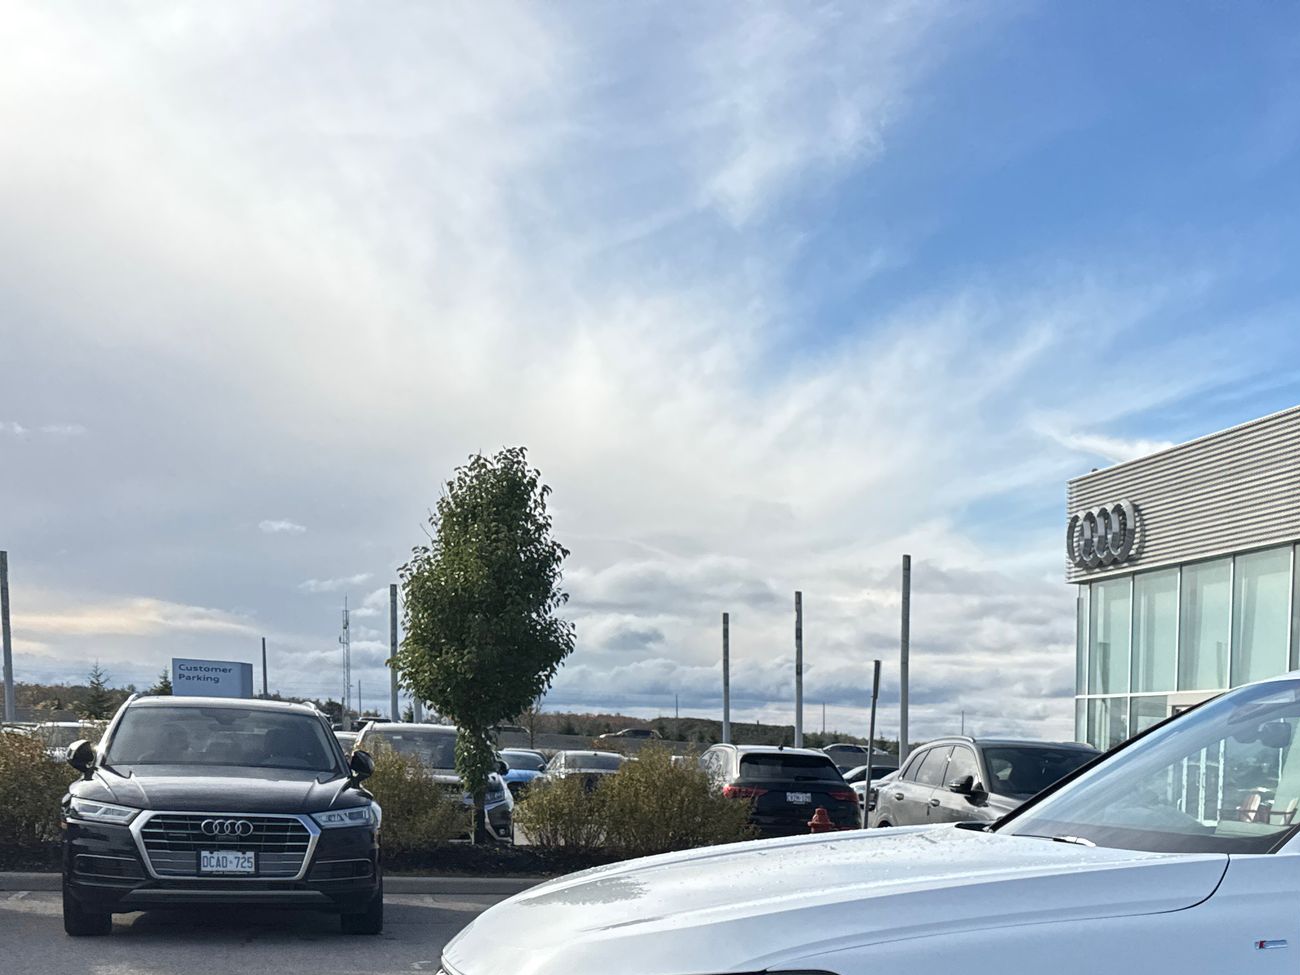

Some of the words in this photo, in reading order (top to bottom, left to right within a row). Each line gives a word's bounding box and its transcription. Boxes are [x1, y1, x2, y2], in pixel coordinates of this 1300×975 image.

[178, 664, 232, 674] Customer
[178, 673, 220, 684] Parking
[234, 856, 253, 869] 725
